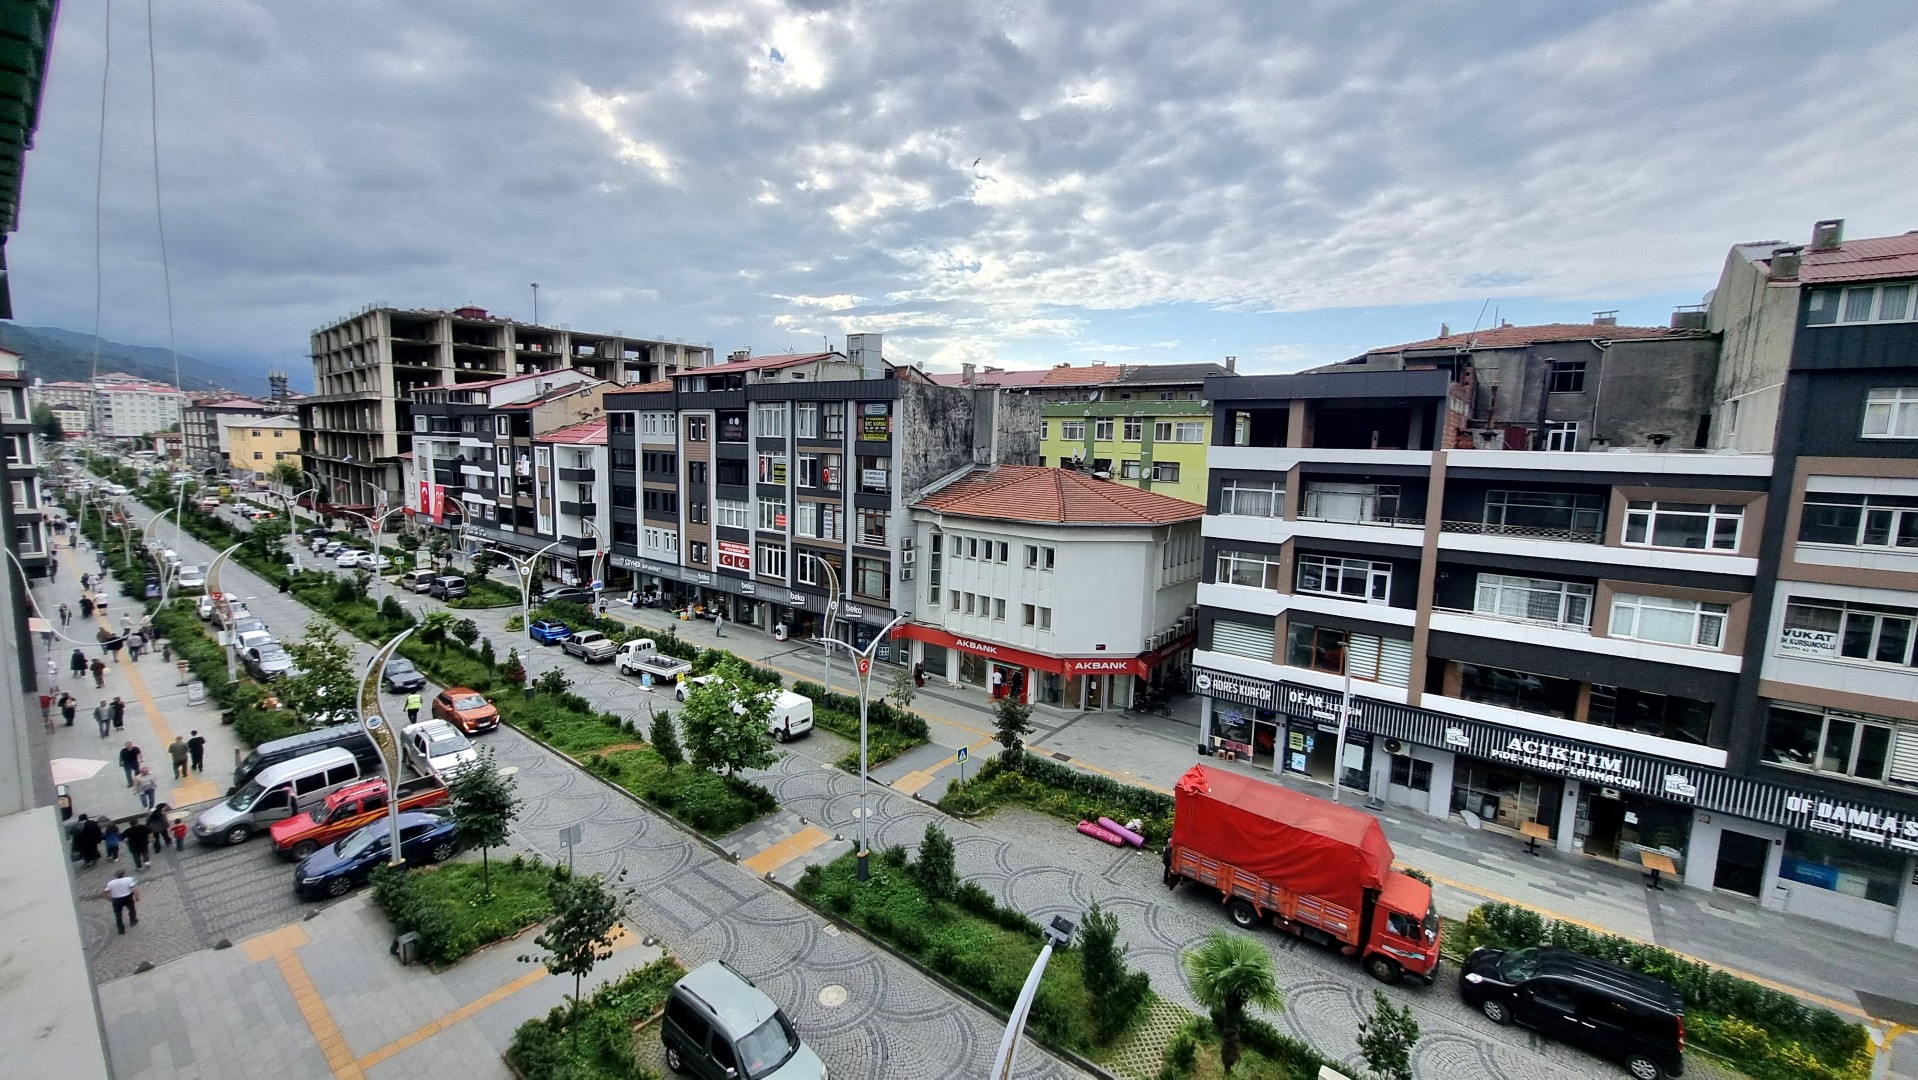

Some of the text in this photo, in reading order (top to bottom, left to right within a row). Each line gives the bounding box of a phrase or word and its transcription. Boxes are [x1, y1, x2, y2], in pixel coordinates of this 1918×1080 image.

[742, 581, 755, 590] beko
[790, 592, 805, 602] beko
[846, 603, 862, 614] beko
[956, 639, 997, 654] AKBANK
[1213, 679, 1239, 694] ADRES
[1786, 796, 1814, 814] OF
